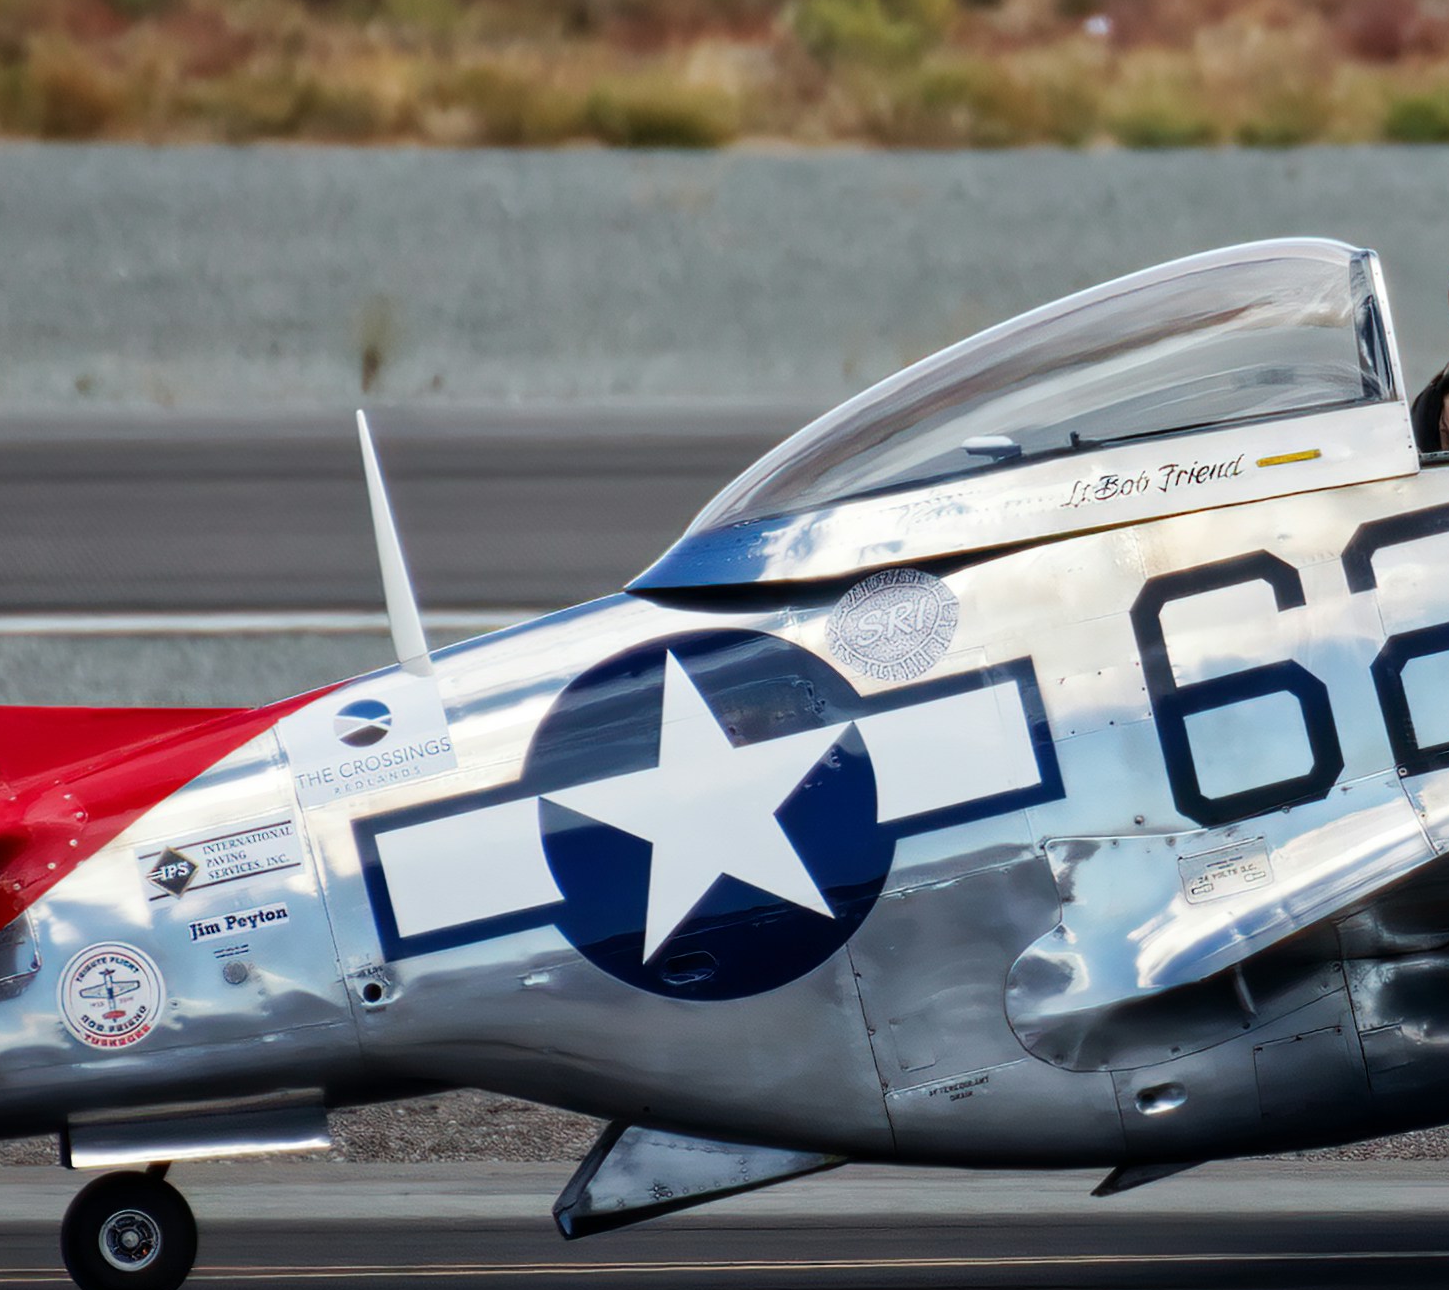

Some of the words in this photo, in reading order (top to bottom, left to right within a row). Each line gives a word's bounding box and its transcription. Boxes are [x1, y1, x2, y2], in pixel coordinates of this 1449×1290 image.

[1094, 470, 1151, 501] Bob
[1157, 453, 1246, 493] Friend
[856, 596, 927, 646] SRI
[295, 767, 335, 789] THE
[339, 736, 451, 778] CROSSINGS
[334, 765, 422, 795] REDLANDS
[202, 826, 294, 855] INTERNATIONAL
[160, 861, 190, 881] IPS
[206, 850, 247, 868] PAVING
[266, 854, 290, 867] INC.
[189, 923, 221, 941] Jim
[224, 908, 288, 930] Peyton
